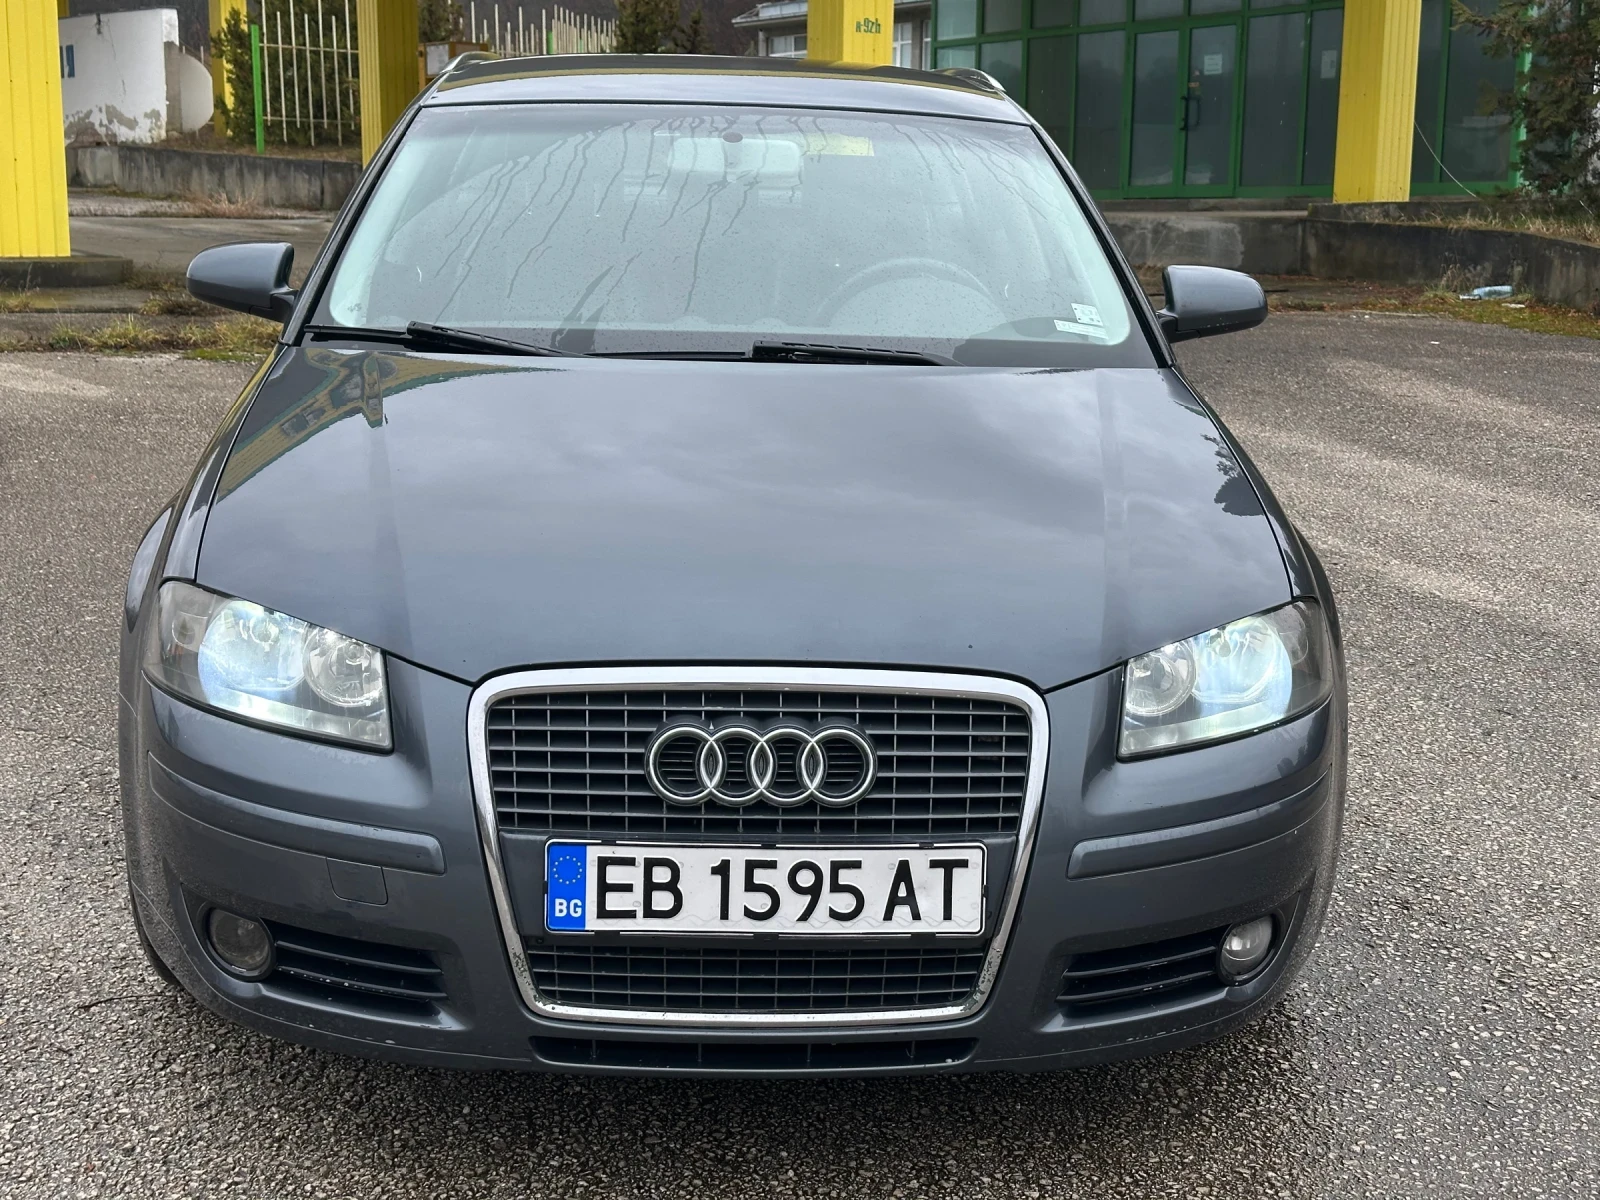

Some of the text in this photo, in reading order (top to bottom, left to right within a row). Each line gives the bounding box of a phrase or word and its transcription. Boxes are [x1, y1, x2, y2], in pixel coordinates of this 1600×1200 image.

[554, 898, 582, 917] BG
[597, 855, 969, 922] EB 1595 AT
